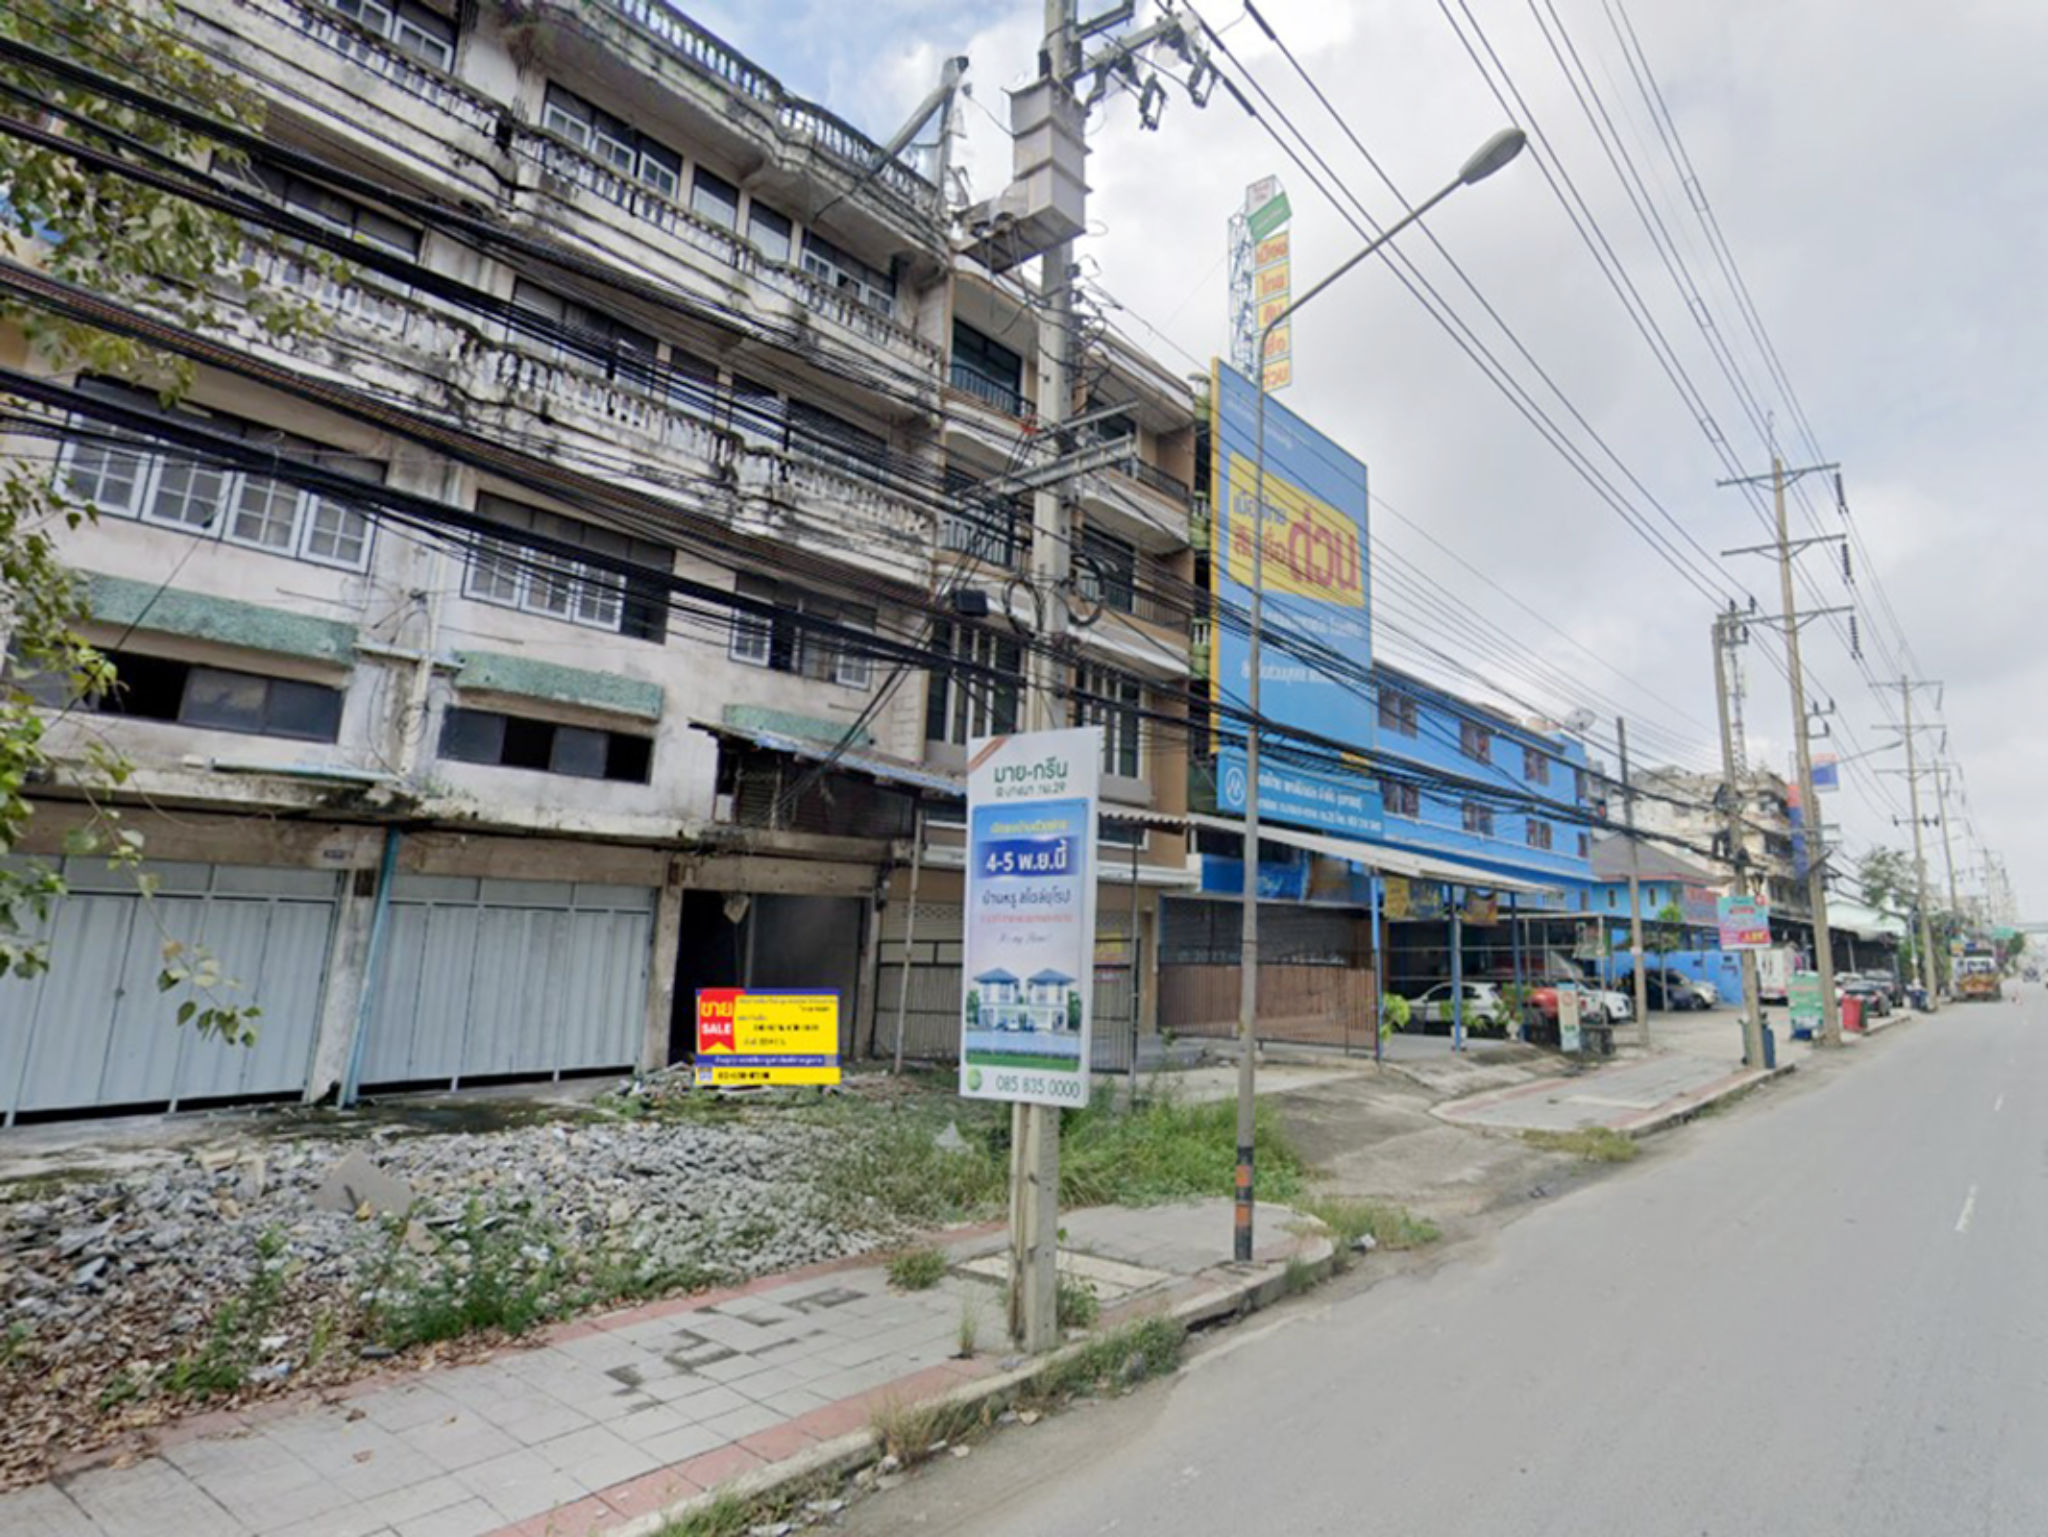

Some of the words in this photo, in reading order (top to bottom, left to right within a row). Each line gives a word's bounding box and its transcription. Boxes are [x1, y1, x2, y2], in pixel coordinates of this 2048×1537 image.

[1287, 505, 1359, 591] ด่วน
[994, 757, 1069, 783] มาย-กรีน
[986, 851, 1015, 872] 4-5
[1017, 839, 1067, 871] พ.ย.นี้
[702, 1022, 731, 1035] SALE
[995, 1074, 1019, 1092] 085
[1022, 1077, 1046, 1095] 835
[1048, 1079, 1081, 1099] 0000
